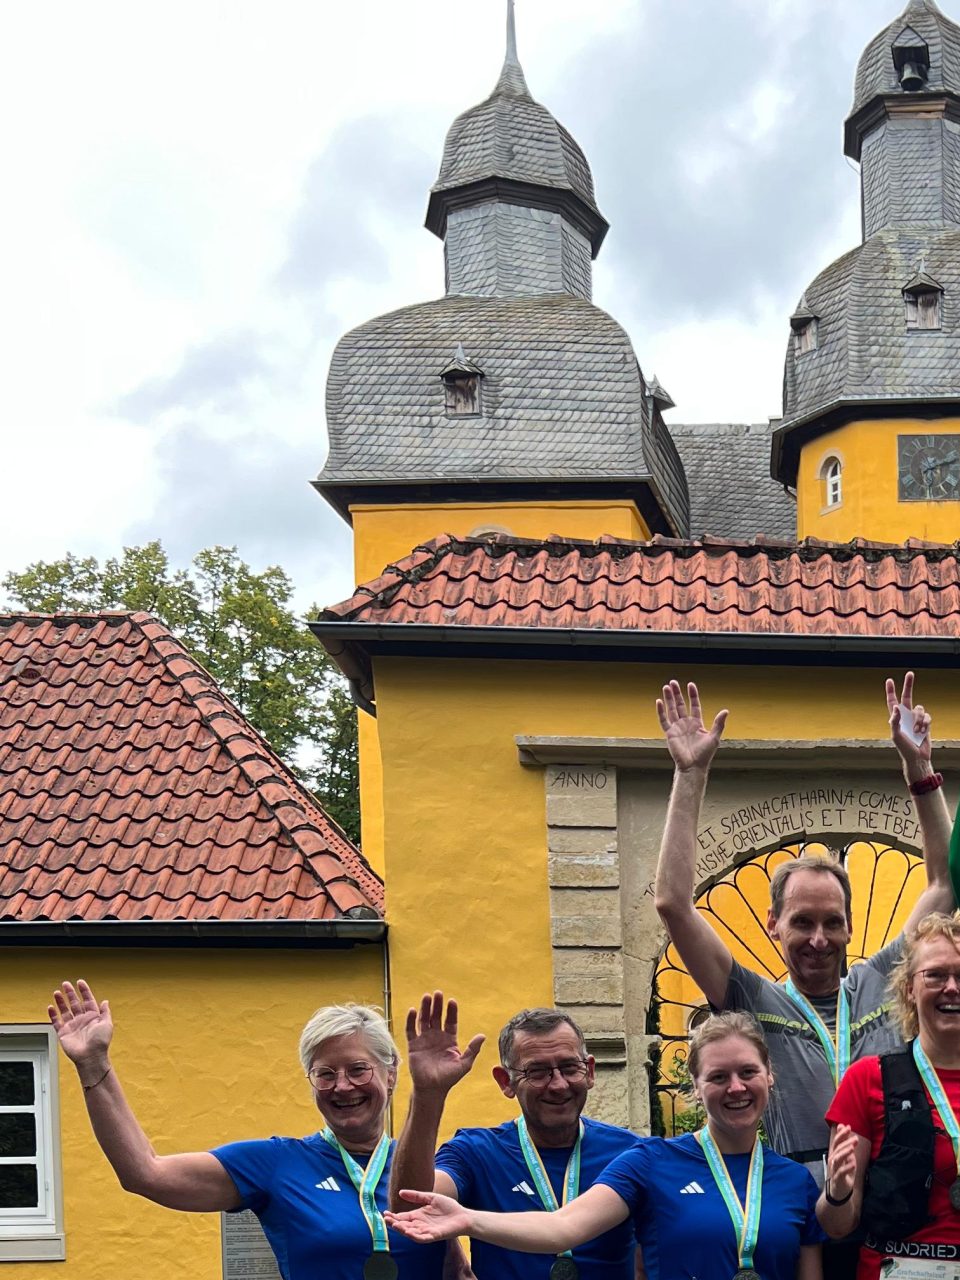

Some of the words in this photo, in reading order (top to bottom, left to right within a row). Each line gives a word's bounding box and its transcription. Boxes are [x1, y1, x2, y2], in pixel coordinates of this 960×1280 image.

[551, 772, 607, 789] ANNO
[697, 827, 717, 850] ET
[858, 790, 913, 816] COMES
[732, 809, 814, 850] ORIENTALIS
[822, 809, 846, 827] ET
[885, 1240, 957, 1258] SUNDRIED
